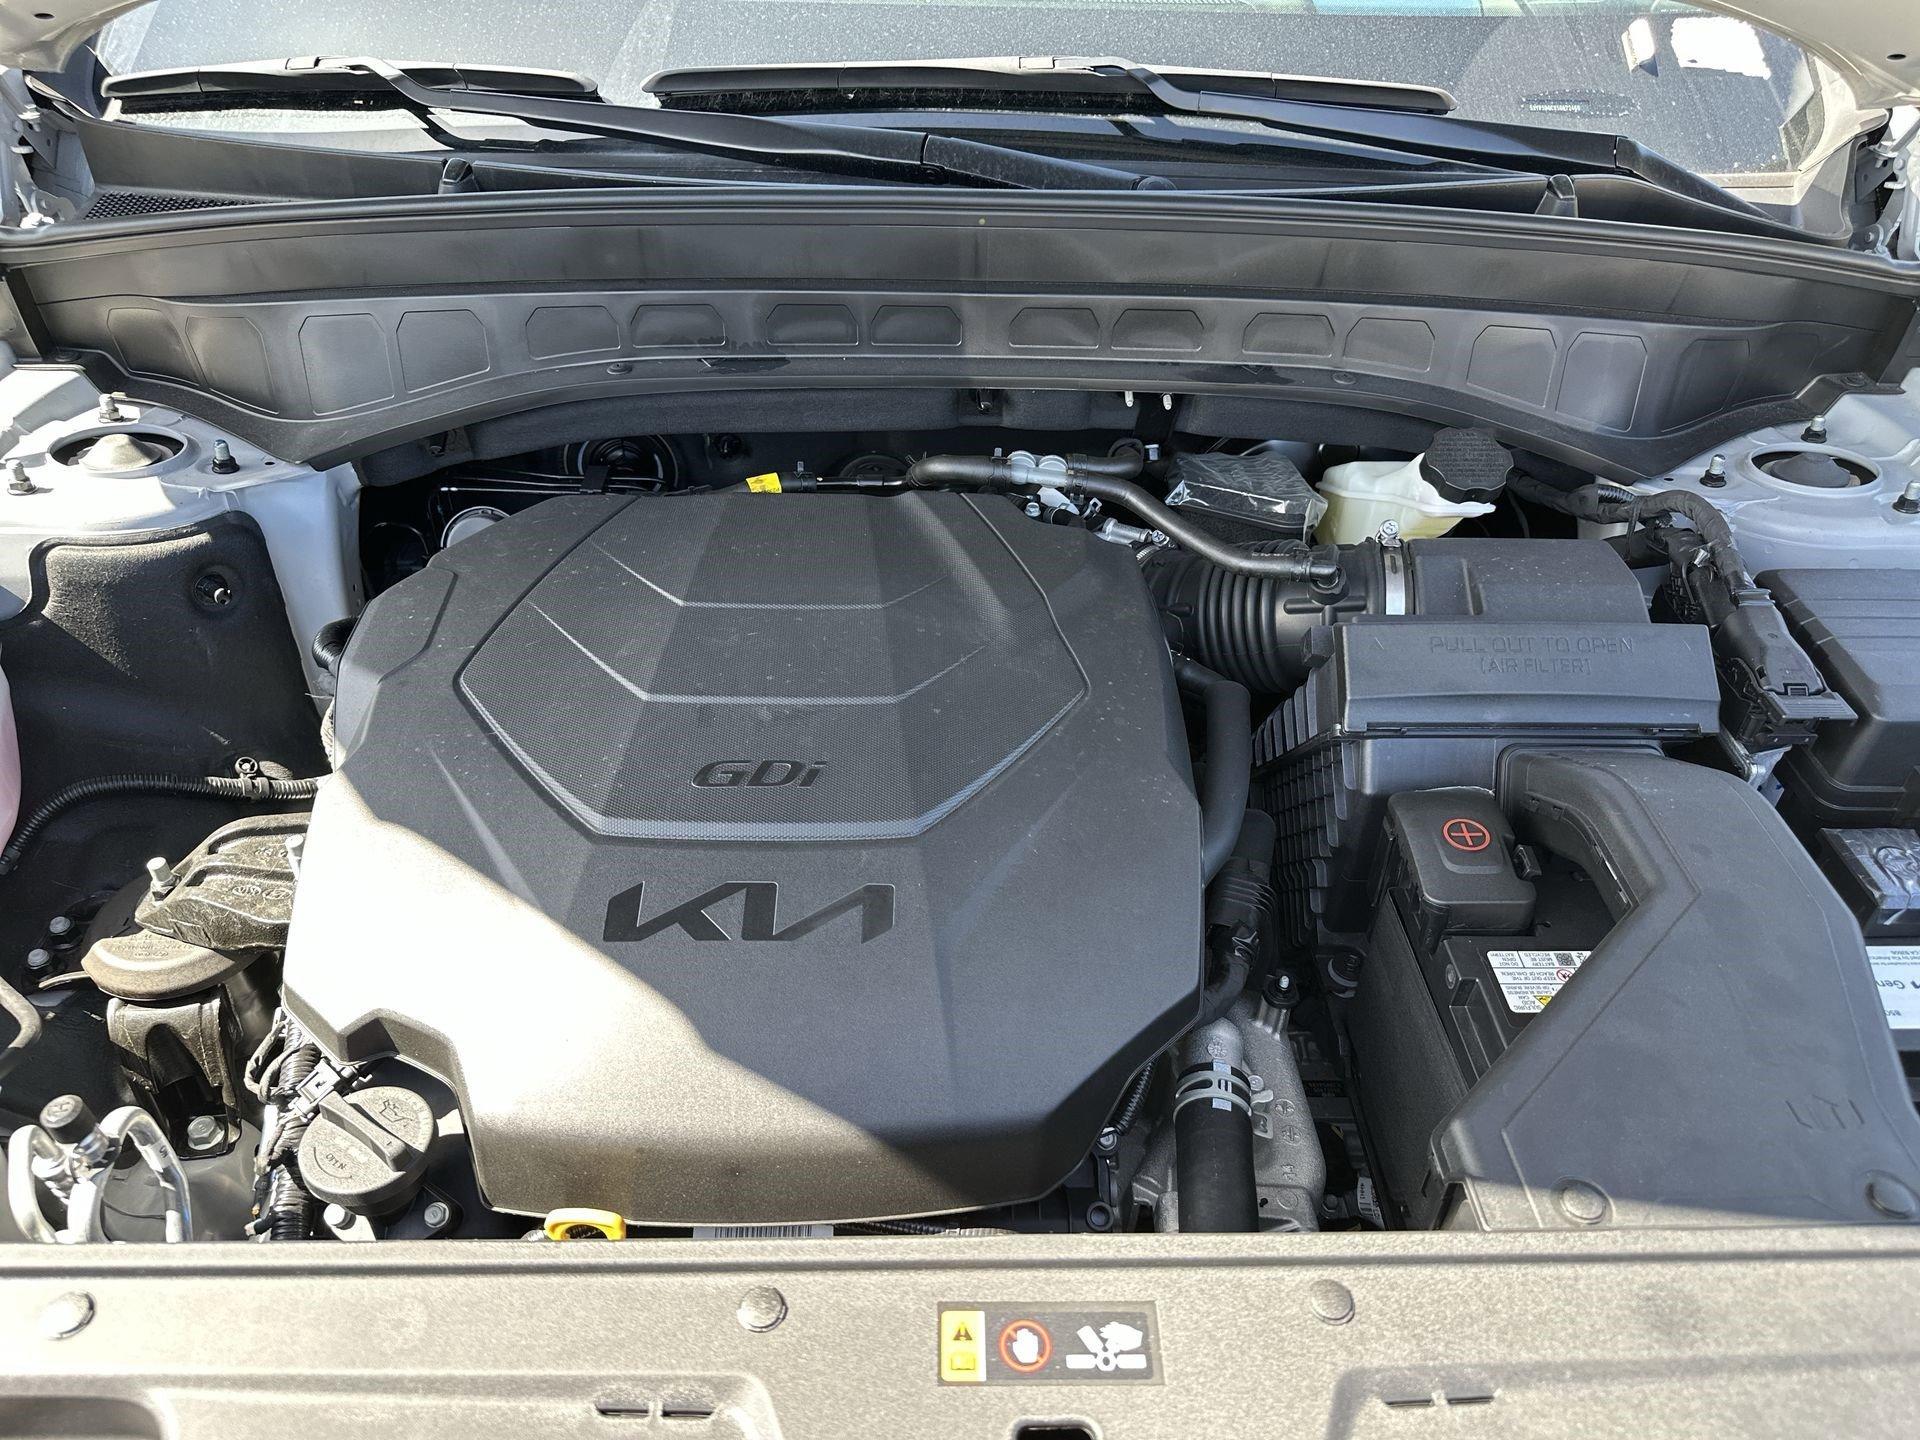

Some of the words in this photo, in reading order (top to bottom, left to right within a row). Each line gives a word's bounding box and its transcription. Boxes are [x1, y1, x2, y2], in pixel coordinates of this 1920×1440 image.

[1430, 636, 1487, 653] PULL
[1492, 636, 1535, 653] OUT
[1541, 636, 1570, 653] TO
[1577, 637, 1634, 656] OPEN
[692, 759, 827, 788] GDi
